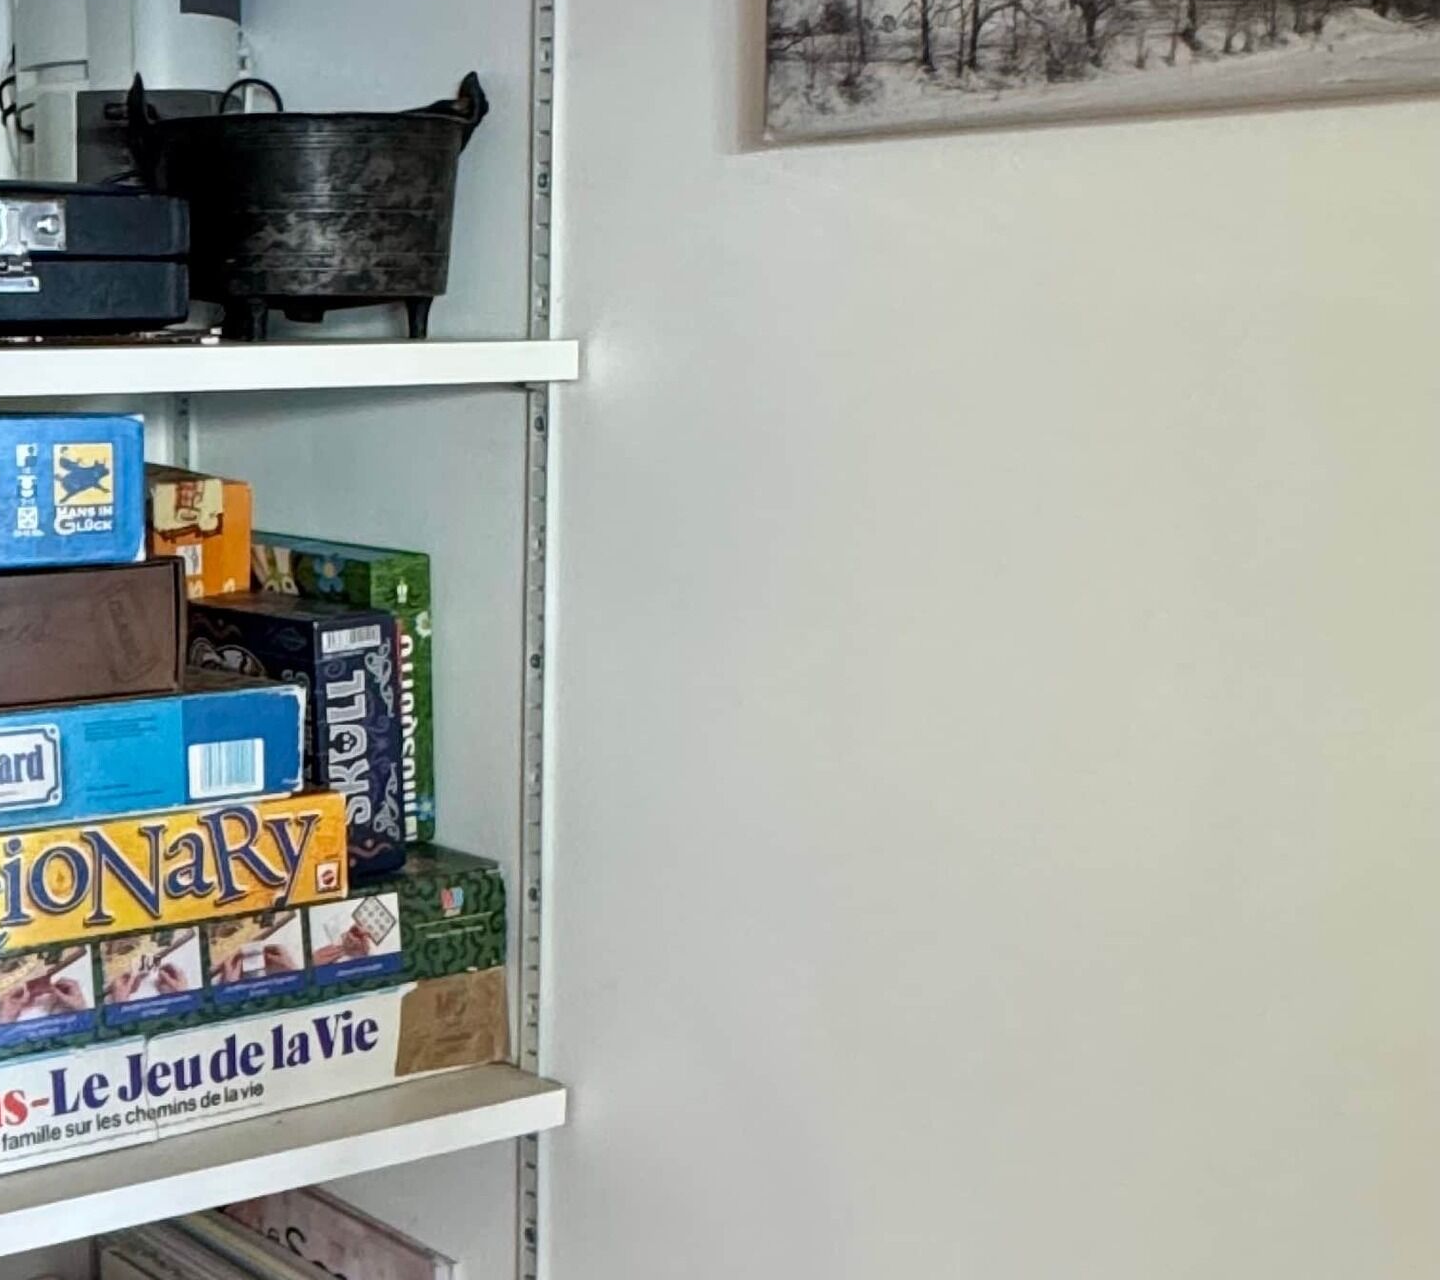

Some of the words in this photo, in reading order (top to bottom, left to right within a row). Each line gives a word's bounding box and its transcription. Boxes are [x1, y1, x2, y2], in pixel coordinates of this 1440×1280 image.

[325, 669, 372, 825] SKULL
[117, 1051, 202, 1102] Jeu
[209, 1032, 265, 1084] de
[271, 1023, 312, 1071] la
[311, 1009, 380, 1060] Vie
[1, 1124, 61, 1152] famille
[64, 1119, 92, 1138] sur
[96, 1113, 122, 1131] les
[124, 1096, 197, 1125] chemins
[200, 1090, 222, 1110] de
[223, 1085, 239, 1103] la
[240, 1080, 265, 1099] vie
